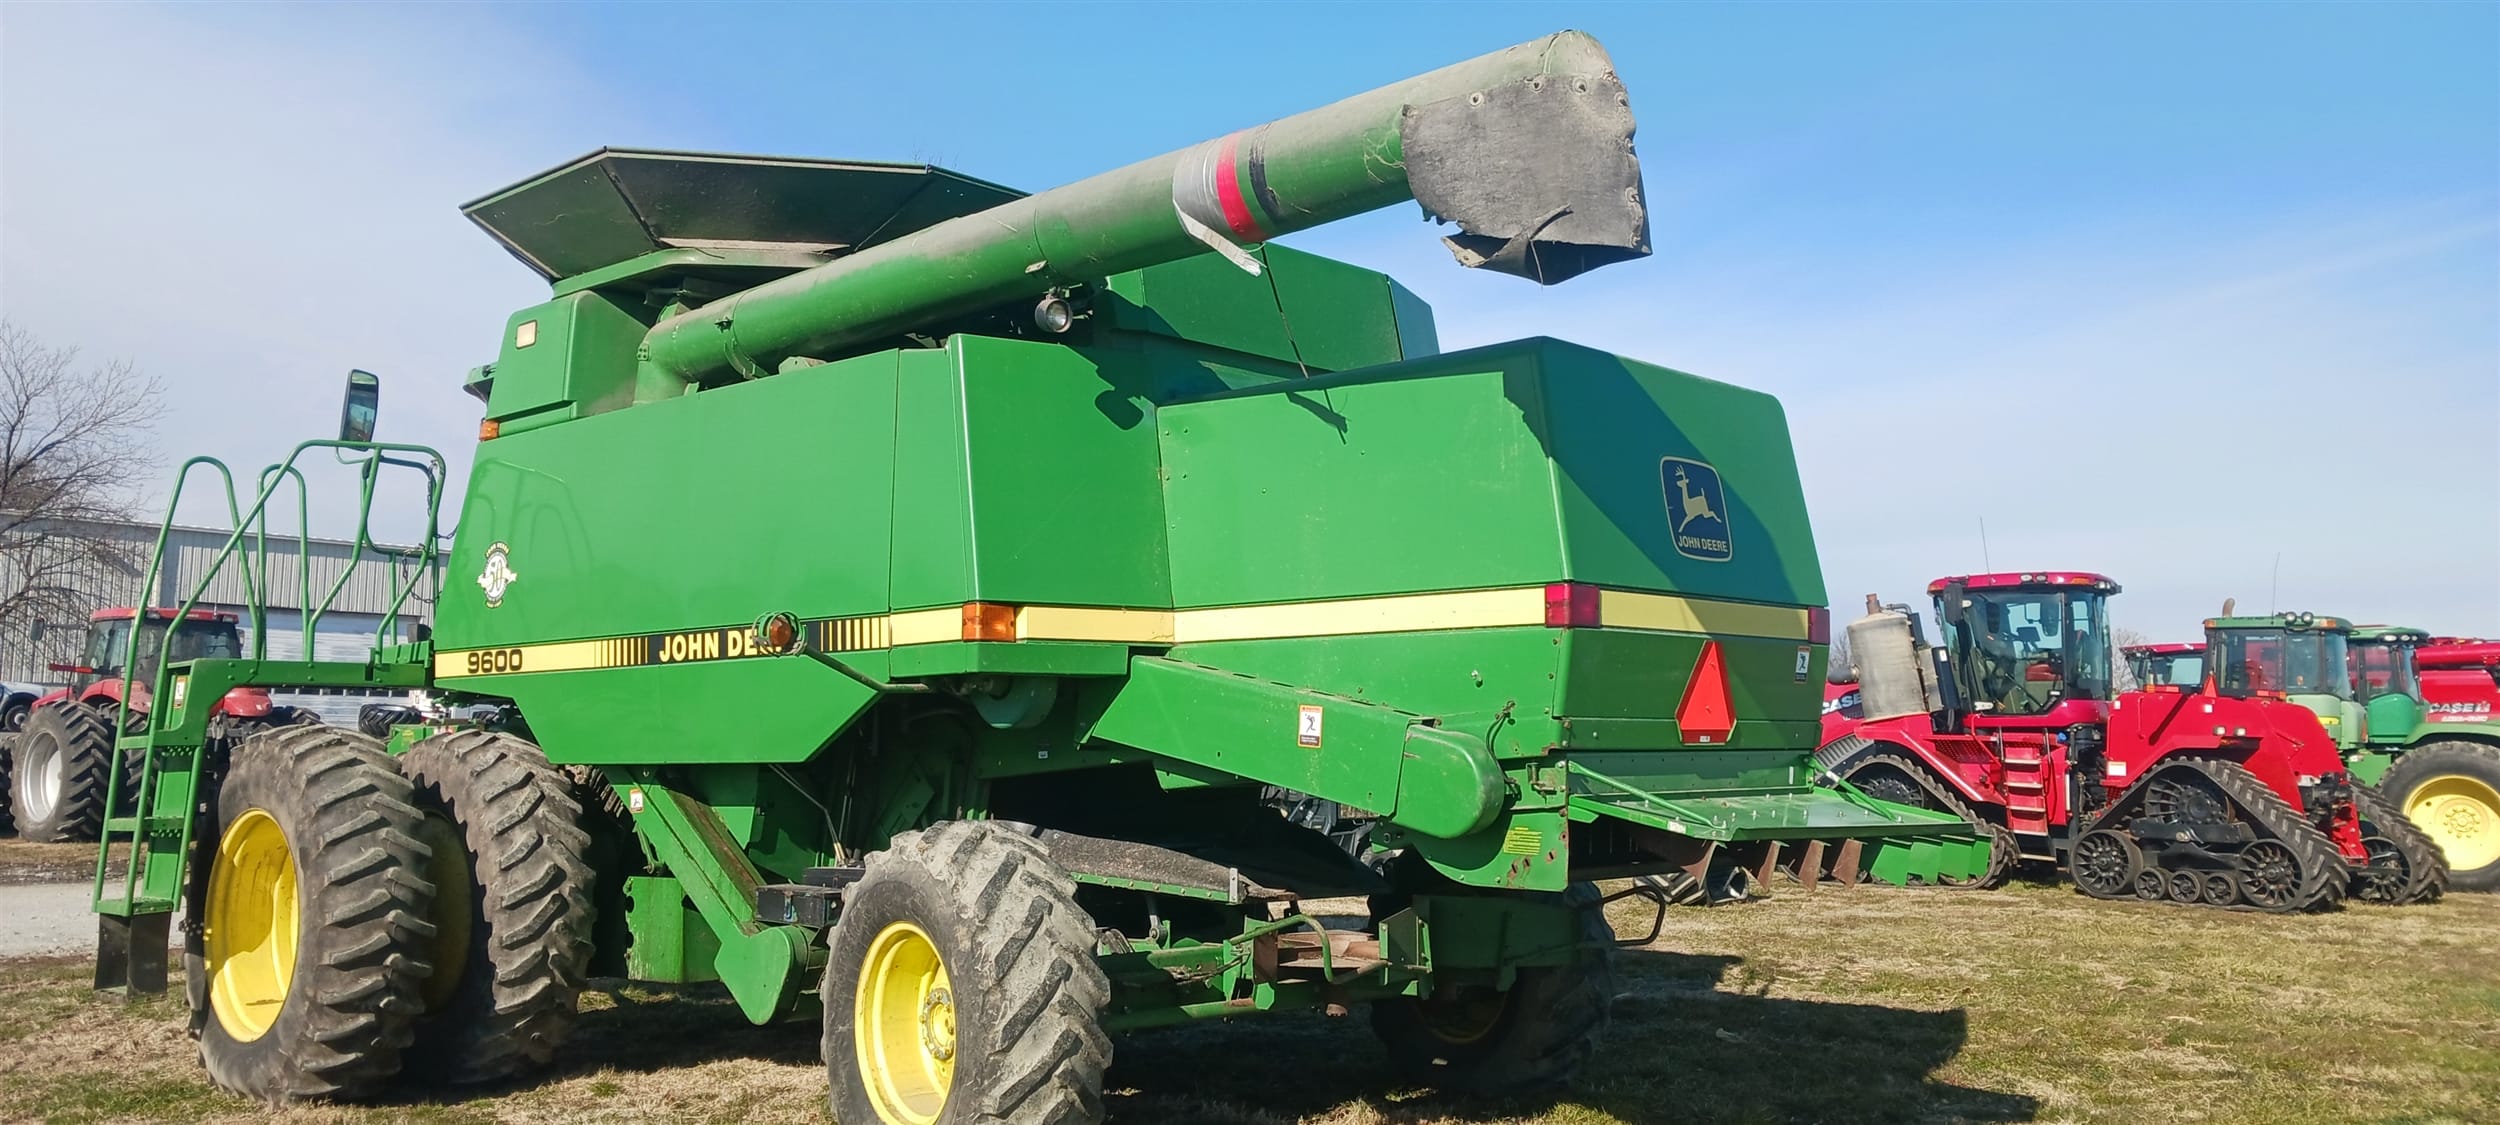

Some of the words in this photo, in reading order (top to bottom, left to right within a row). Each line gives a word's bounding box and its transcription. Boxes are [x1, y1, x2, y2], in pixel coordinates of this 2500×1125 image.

[1678, 535, 1701, 549] JOHN
[1701, 538, 1728, 553] DEERE
[659, 631, 719, 663] JOHN
[467, 648, 523, 674] 9600
[2429, 702, 2474, 713] CASE
